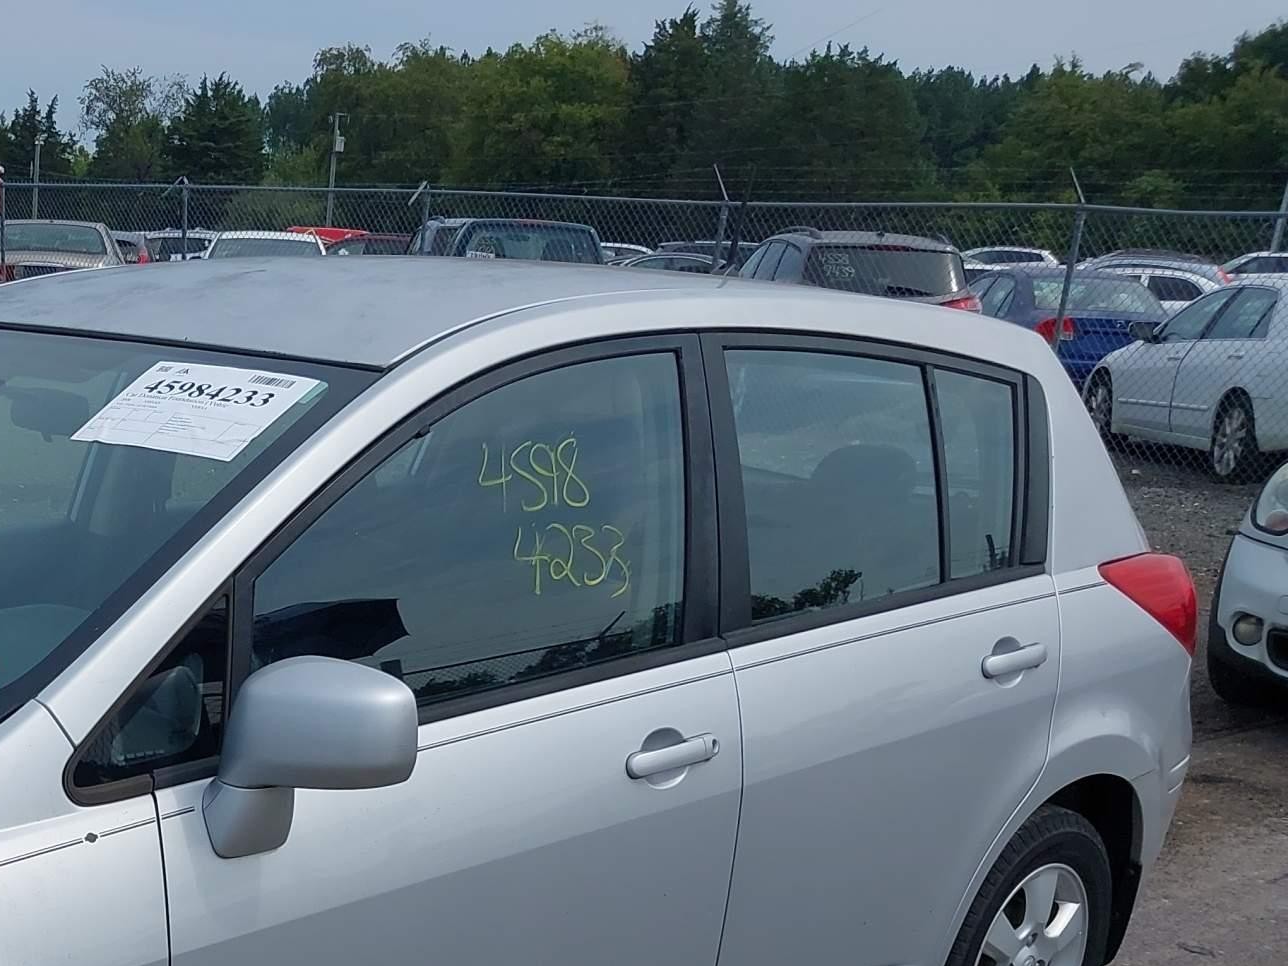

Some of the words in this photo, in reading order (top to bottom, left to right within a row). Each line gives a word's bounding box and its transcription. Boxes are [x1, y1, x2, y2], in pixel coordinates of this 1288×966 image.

[143, 379, 275, 407] 45984233
[479, 431, 589, 513] 4598
[514, 522, 632, 599] 4233
